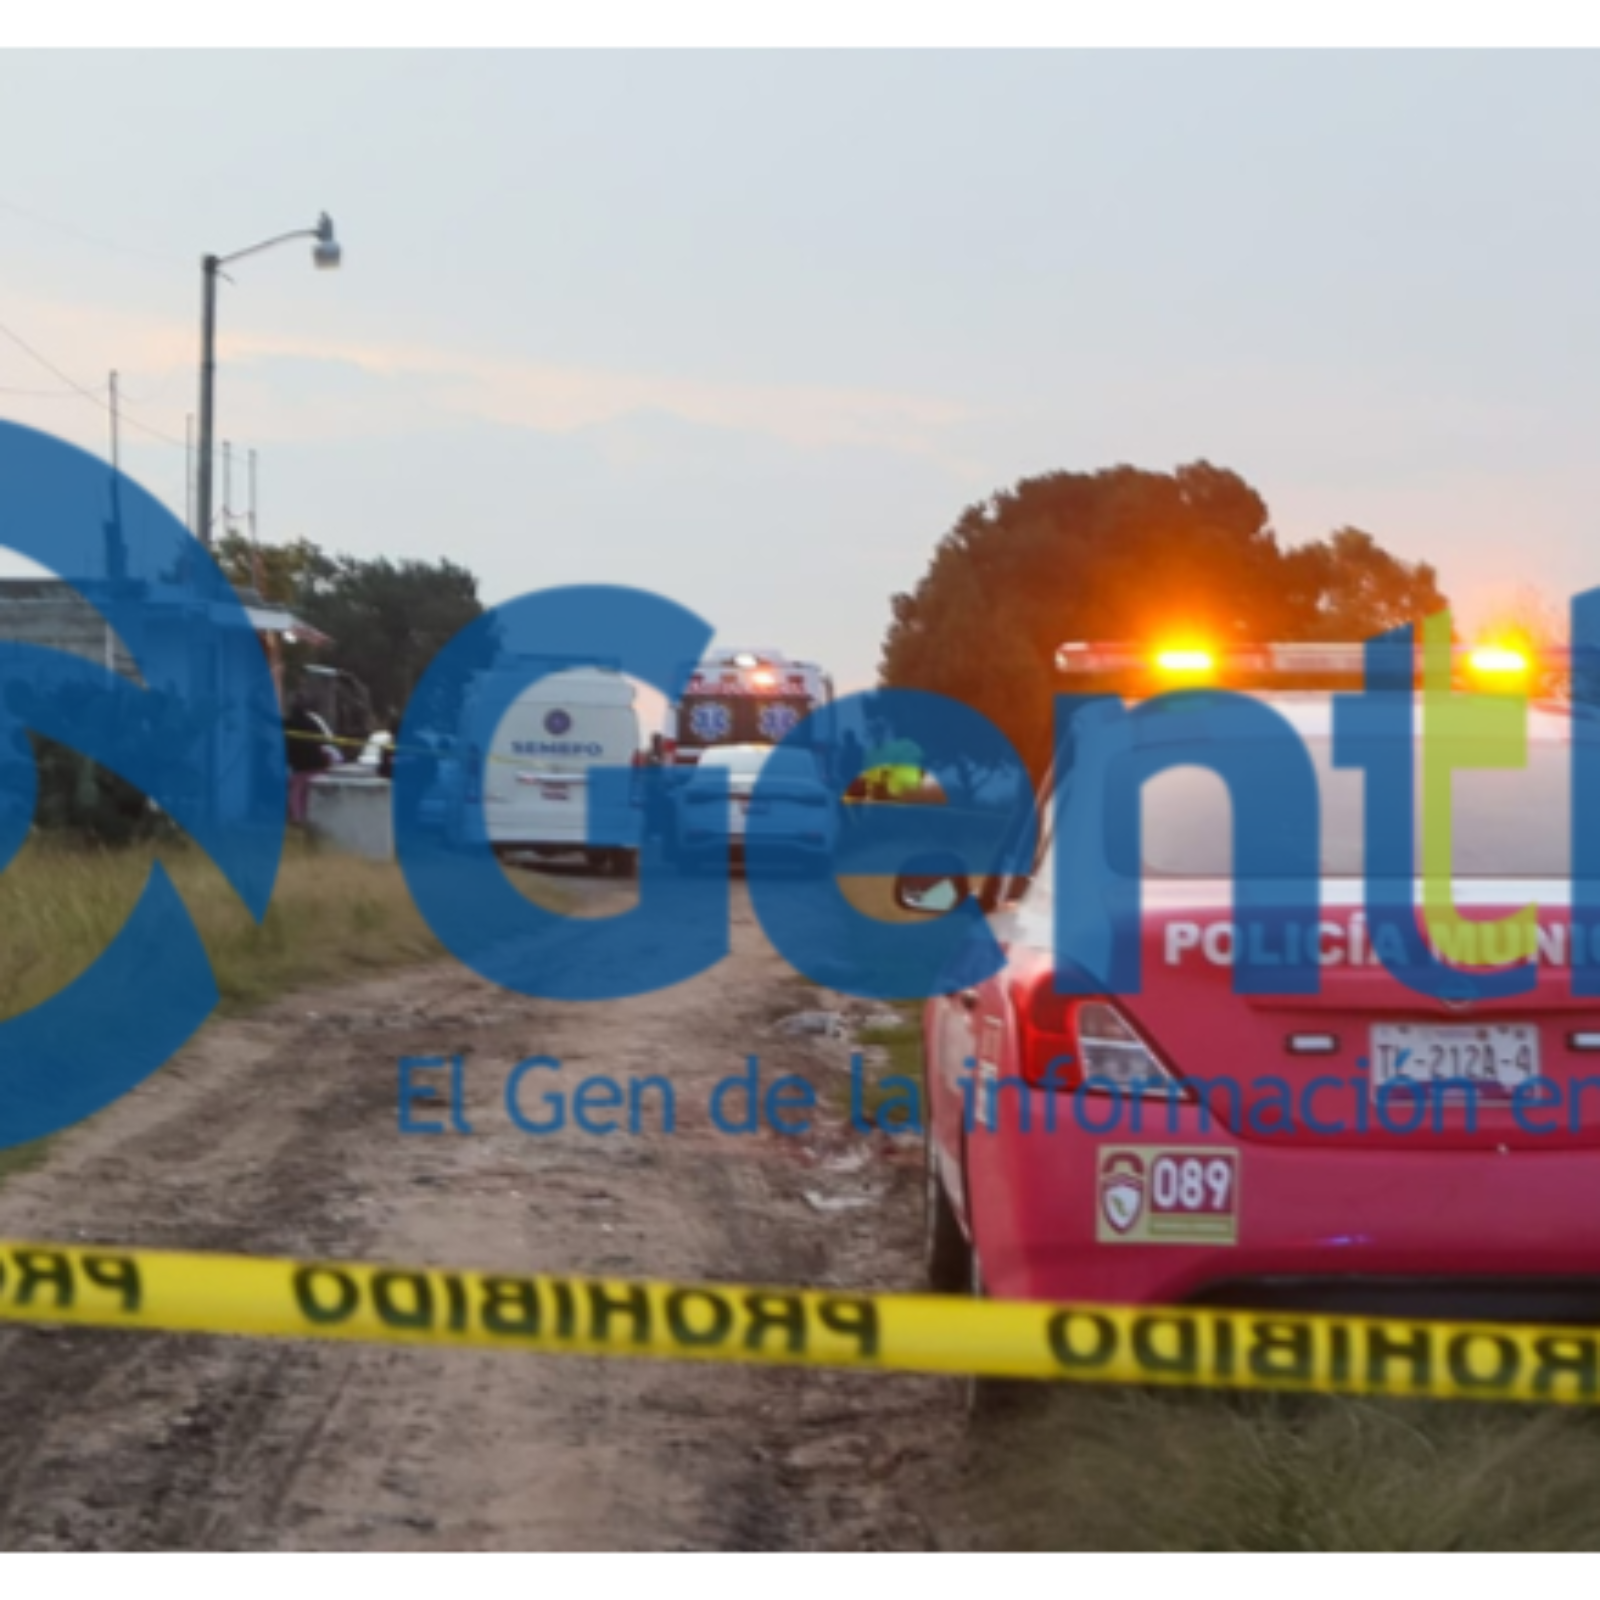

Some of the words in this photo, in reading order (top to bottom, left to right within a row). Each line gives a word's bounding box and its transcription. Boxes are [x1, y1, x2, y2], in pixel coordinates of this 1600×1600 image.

[1164, 911, 1411, 966] POLICÍA
[1427, 921, 1600, 966] MUNI
[1153, 1157, 1231, 1210] 089
